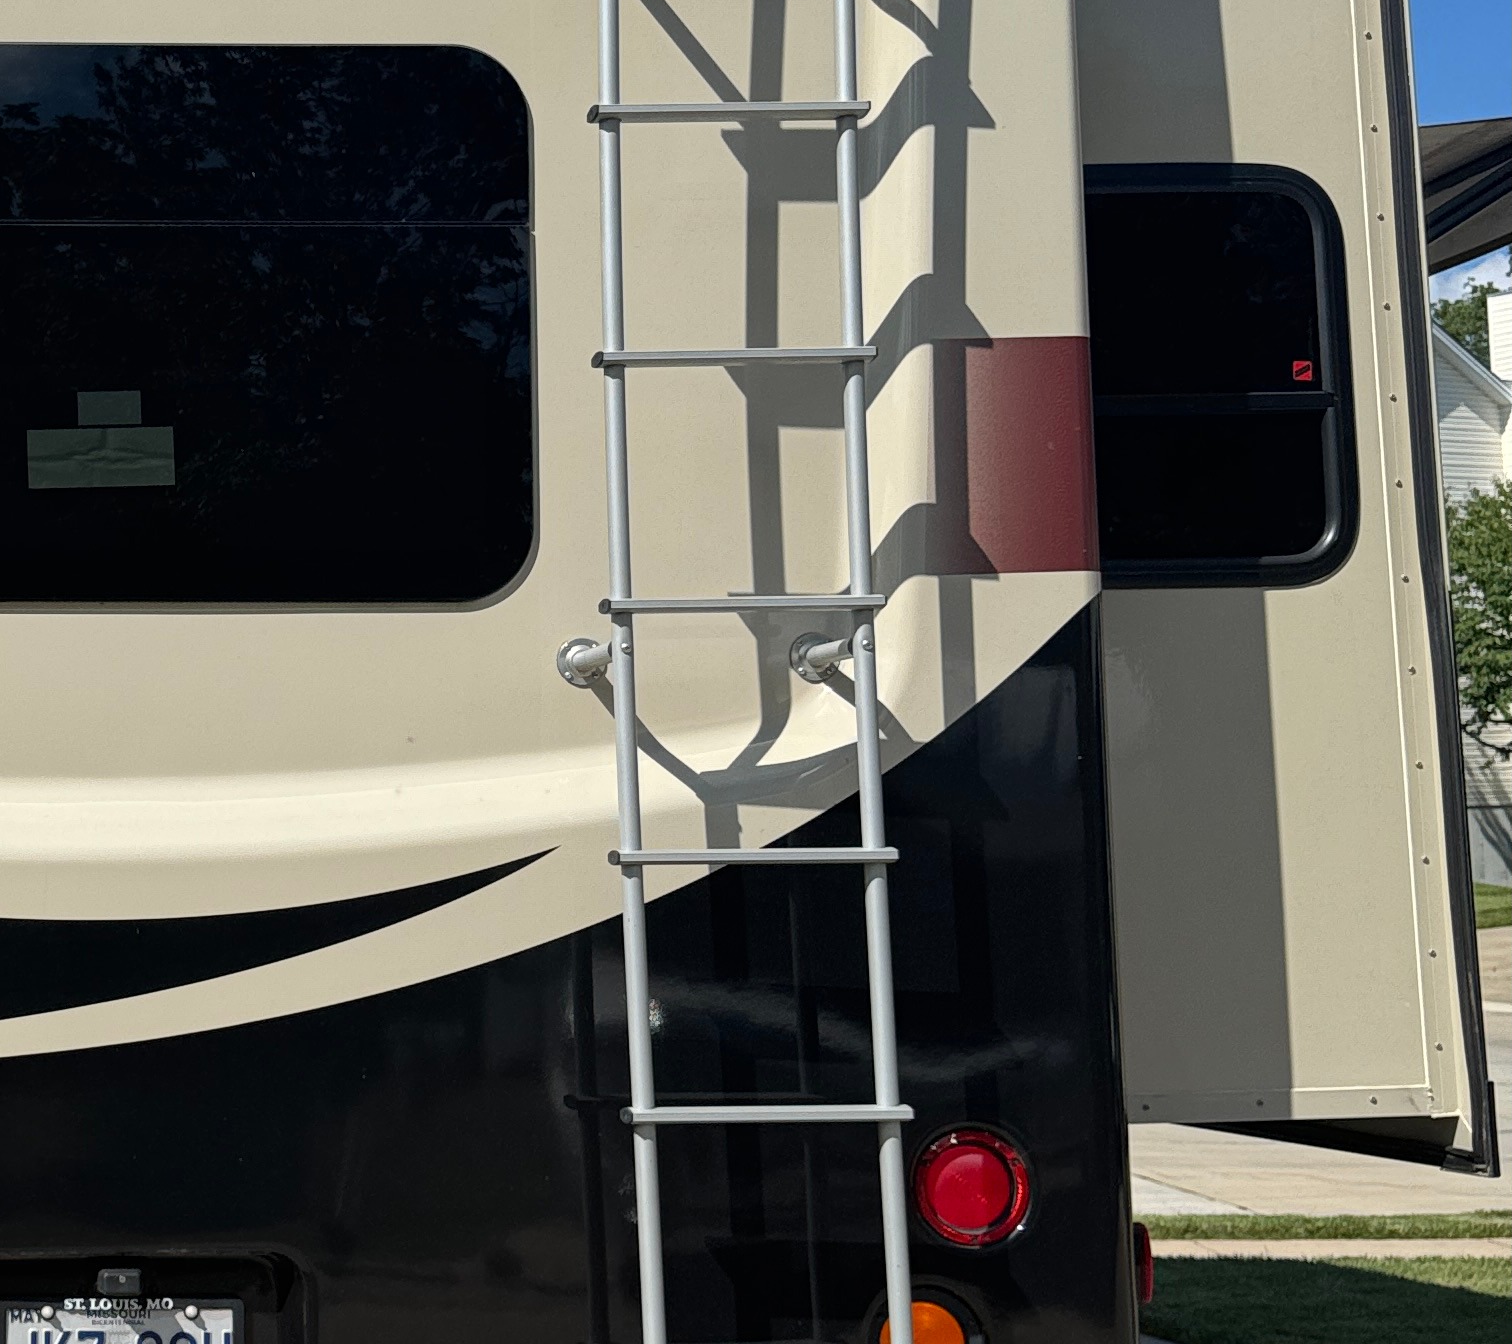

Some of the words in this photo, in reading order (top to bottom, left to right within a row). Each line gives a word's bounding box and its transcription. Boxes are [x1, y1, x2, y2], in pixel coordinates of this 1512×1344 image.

[63, 1297, 86, 1310] ST.
[146, 1298, 174, 1310] MO
[87, 1310, 150, 1318] MISSOURI
